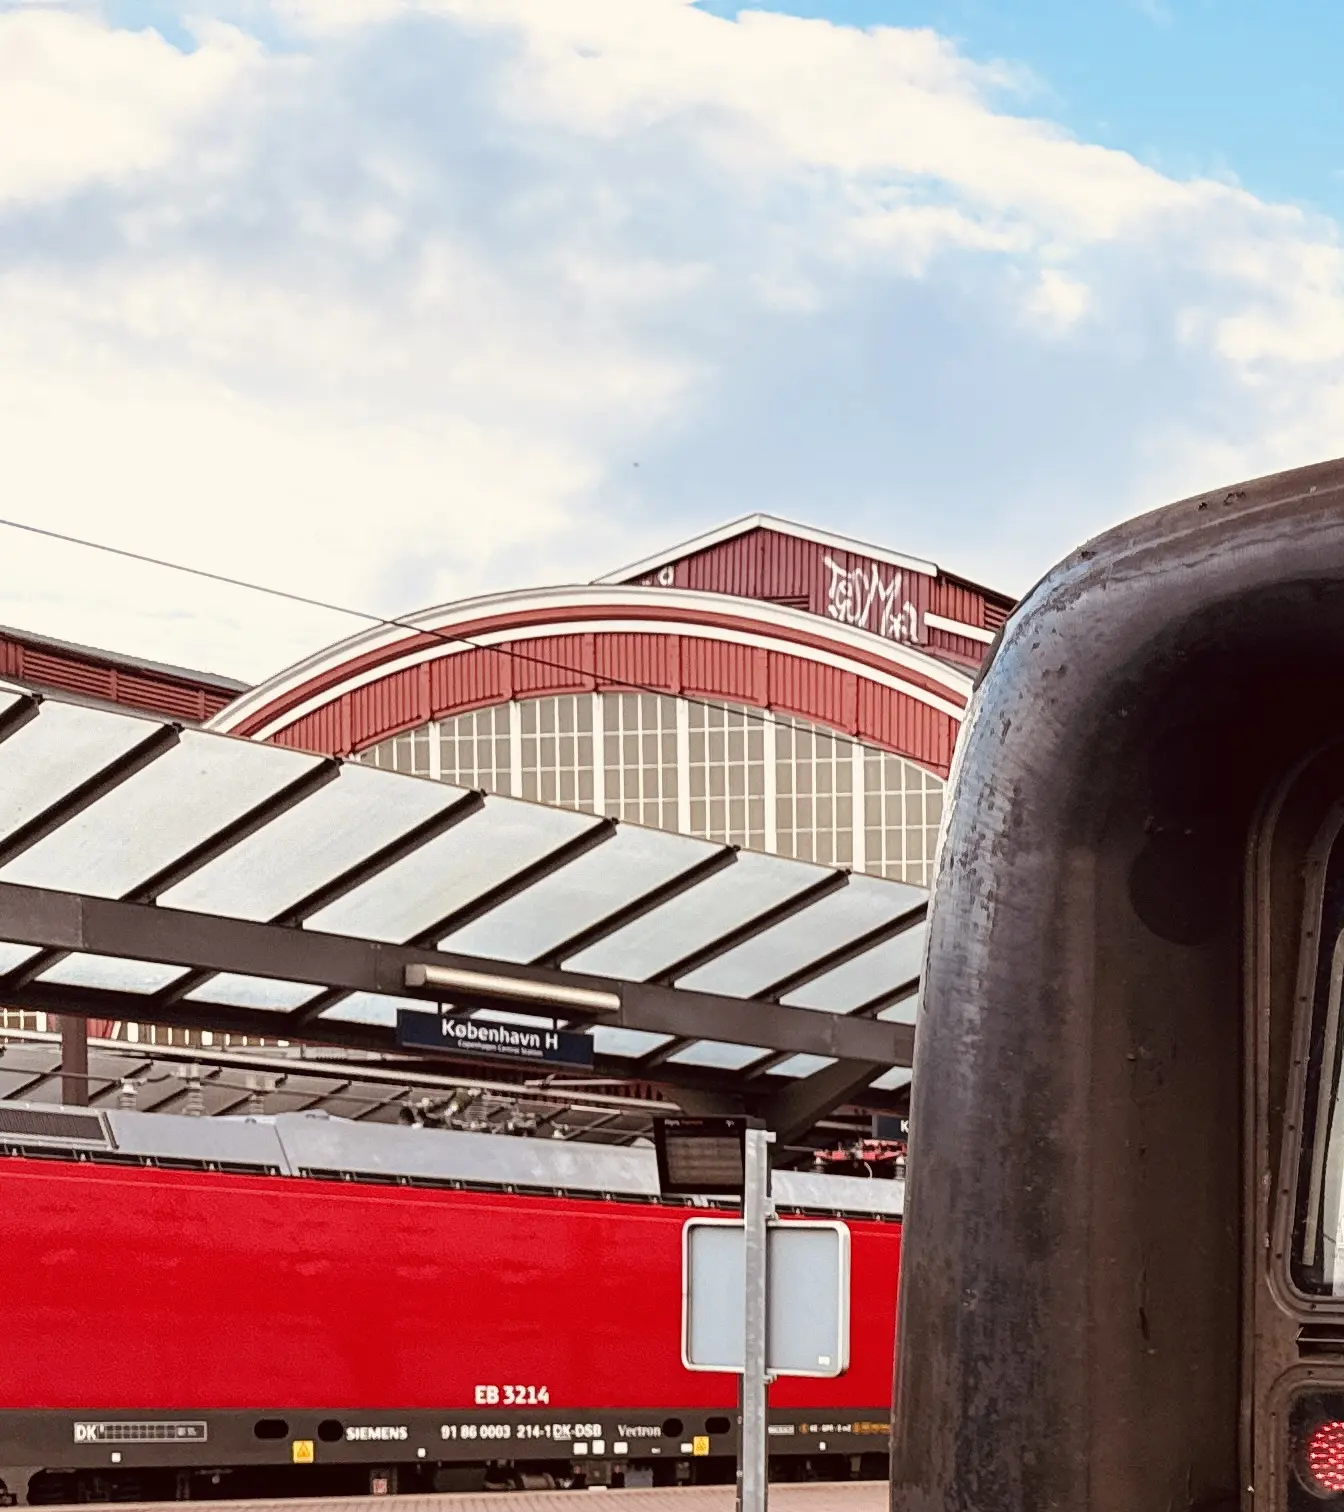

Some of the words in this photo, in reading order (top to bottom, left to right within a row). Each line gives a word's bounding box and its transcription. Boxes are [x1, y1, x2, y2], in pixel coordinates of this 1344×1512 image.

[441, 1018, 540, 1048] København
[545, 1032, 559, 1050] H
[475, 1385, 499, 1405] EB
[503, 1385, 550, 1405] 3214
[76, 1423, 97, 1441] DK
[345, 1426, 408, 1441] SIEMENS
